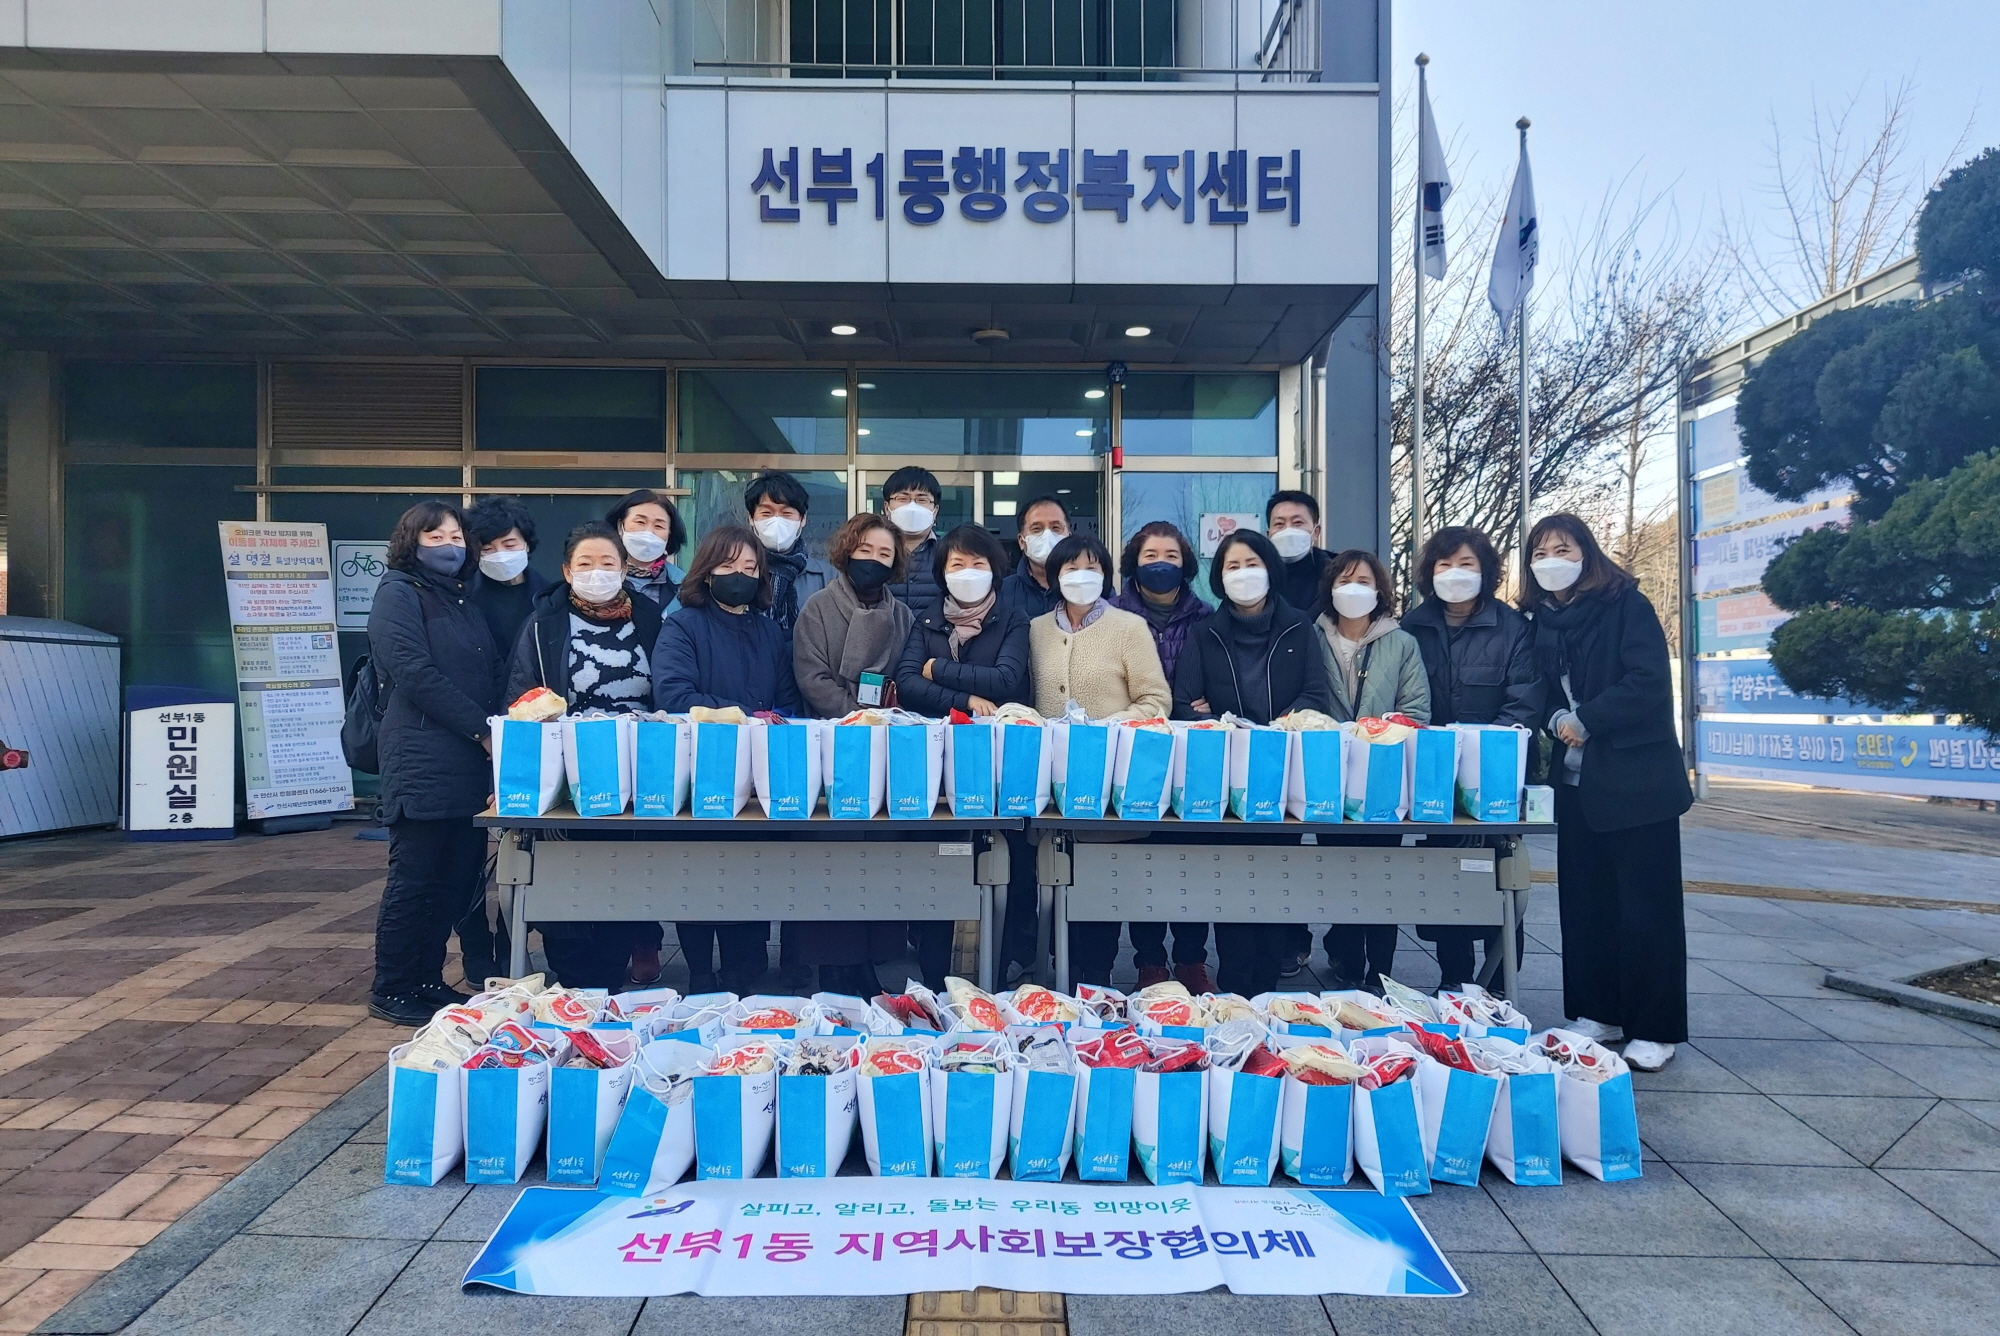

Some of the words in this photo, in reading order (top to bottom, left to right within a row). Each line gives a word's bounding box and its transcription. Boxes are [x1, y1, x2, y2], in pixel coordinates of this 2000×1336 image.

[228, 551, 241, 566] 설
[246, 551, 272, 566] 명절
[158, 712, 206, 723] 선부1동
[166, 726, 197, 809] 민원실
[740, 1202, 821, 1217] 살피고,
[834, 1202, 915, 1216] 알리고,
[928, 1198, 998, 1213] 돌보는
[1010, 1199, 1082, 1216] 우리동
[1094, 1198, 1192, 1214] 희망이웃
[618, 1228, 814, 1263] 선부1동
[834, 1225, 1316, 1262] 지역사회보장협의체
